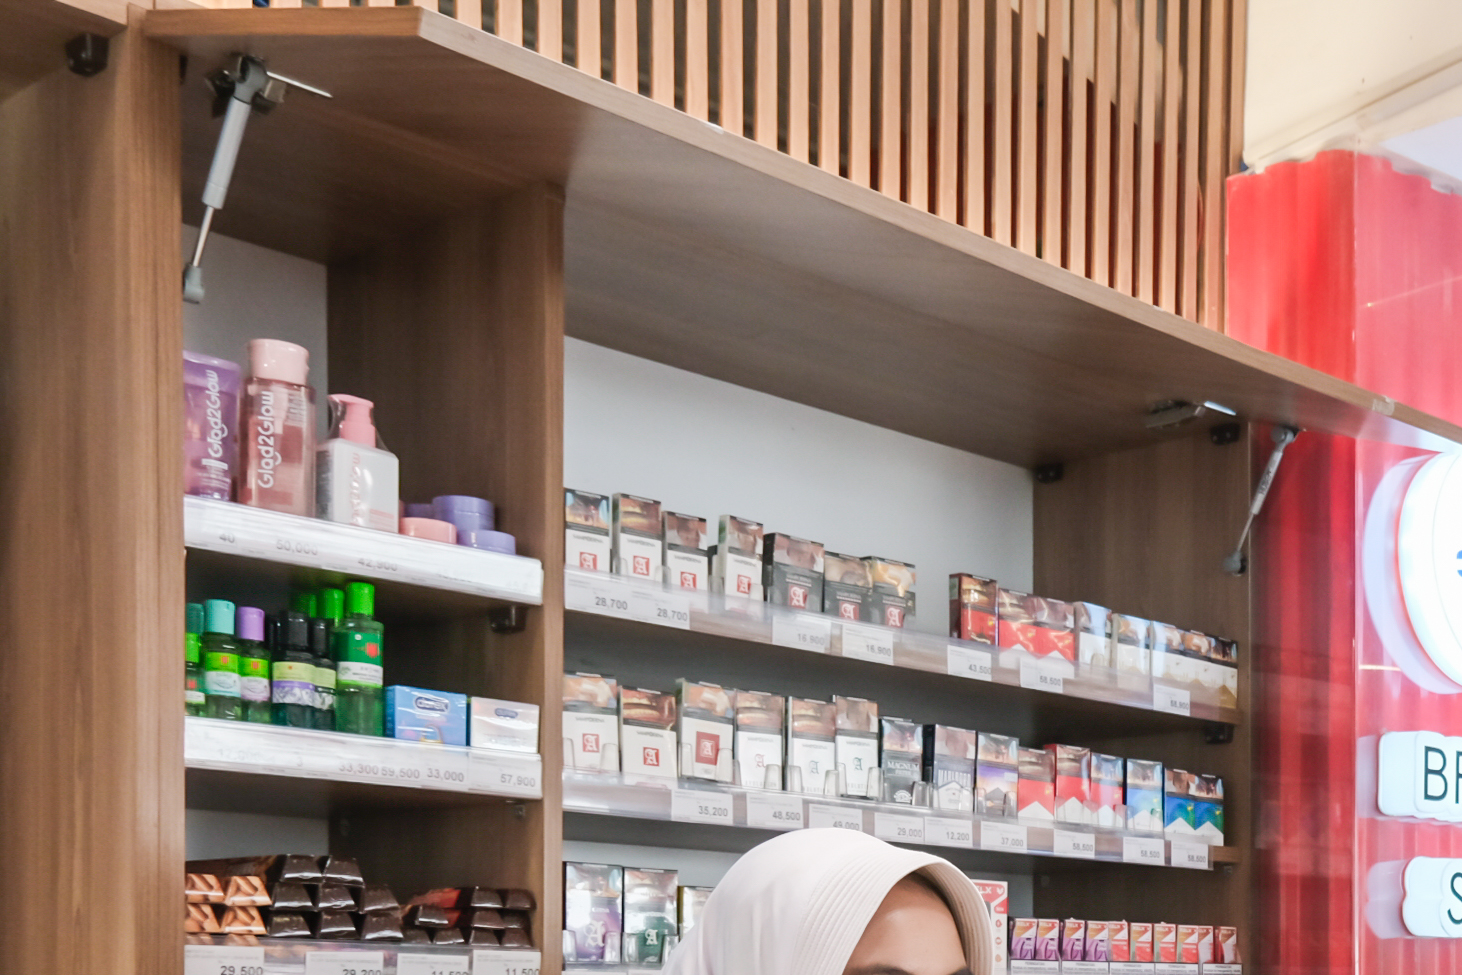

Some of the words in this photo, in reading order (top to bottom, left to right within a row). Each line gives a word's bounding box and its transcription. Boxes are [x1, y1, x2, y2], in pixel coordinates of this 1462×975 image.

[207, 370, 228, 458] Glad2Glow
[258, 391, 282, 488] Glad2Glow
[595, 597, 628, 610] 28,700
[657, 608, 688, 621] 28,700
[887, 761, 919, 770] MAGNUM
[500, 773, 536, 788] 57,900
[698, 806, 728, 817] 35,200
[772, 811, 800, 821] 48,500
[897, 827, 922, 838] 29,000
[946, 831, 969, 841] 12,200
[1001, 837, 1024, 847] 37,000
